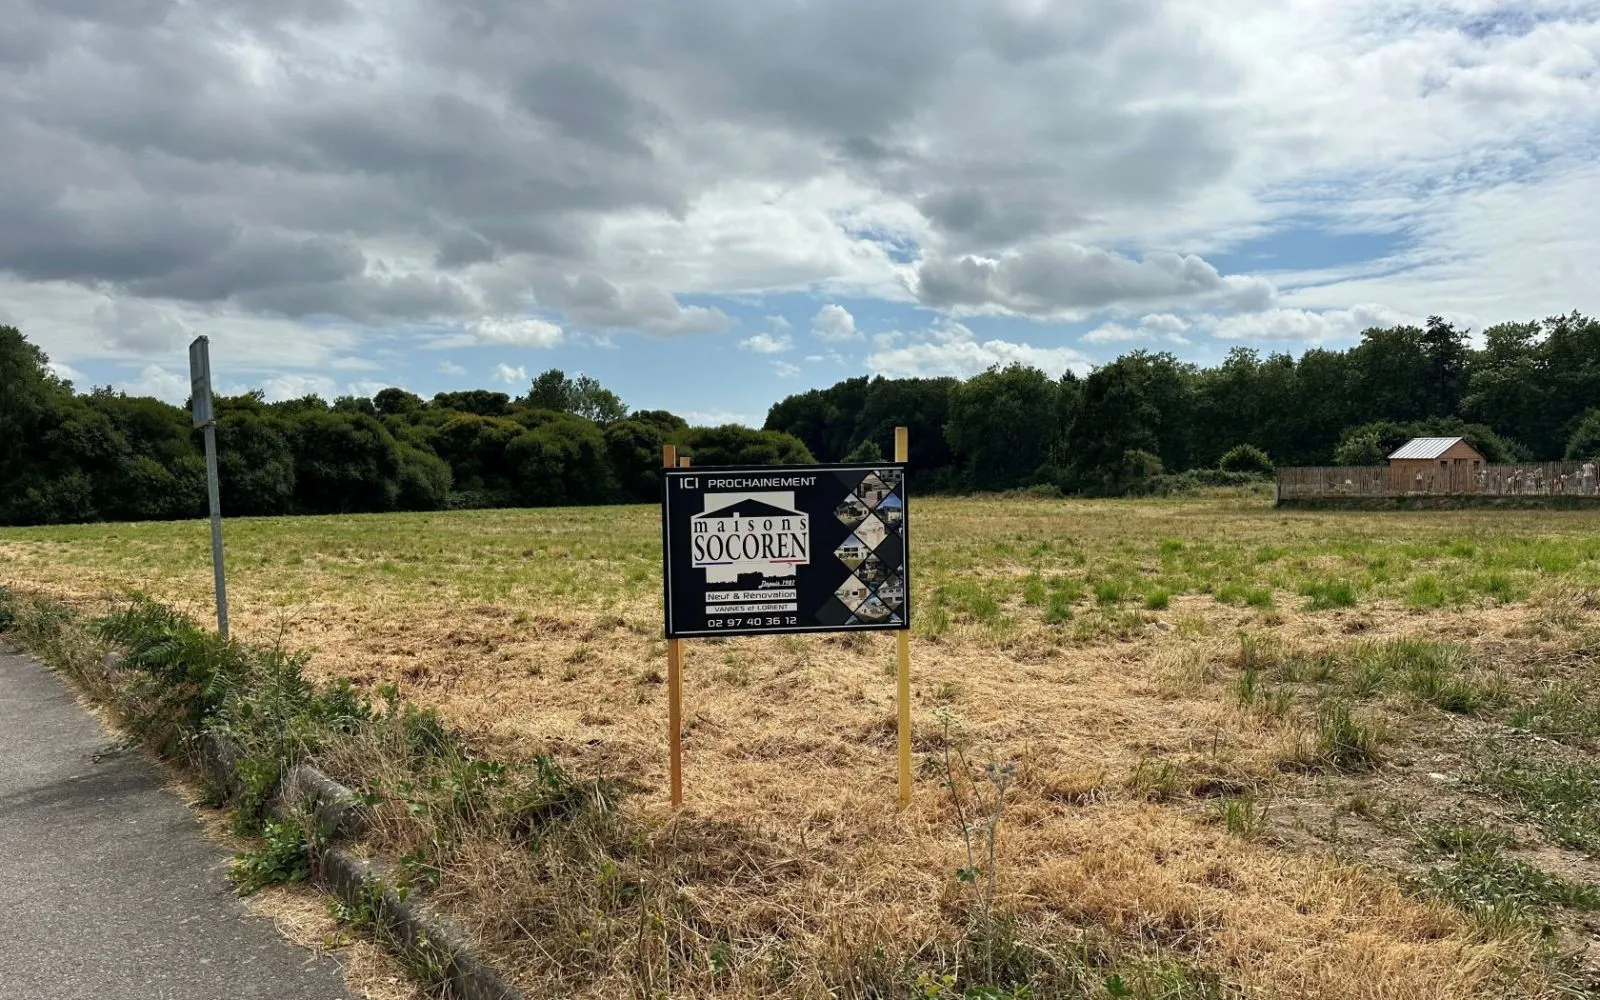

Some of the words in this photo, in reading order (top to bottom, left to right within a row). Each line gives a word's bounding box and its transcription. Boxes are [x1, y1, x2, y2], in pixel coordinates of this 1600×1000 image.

[680, 477, 698, 489] ICI
[708, 477, 816, 488] PROCHAINEMENT
[694, 518, 807, 533] maisons
[694, 532, 807, 561] SOCOREN
[708, 620, 722, 628] 02
[727, 619, 742, 627] 97
[746, 618, 762, 626] 40
[766, 617, 780, 626] 36
[786, 616, 797, 624] 12
